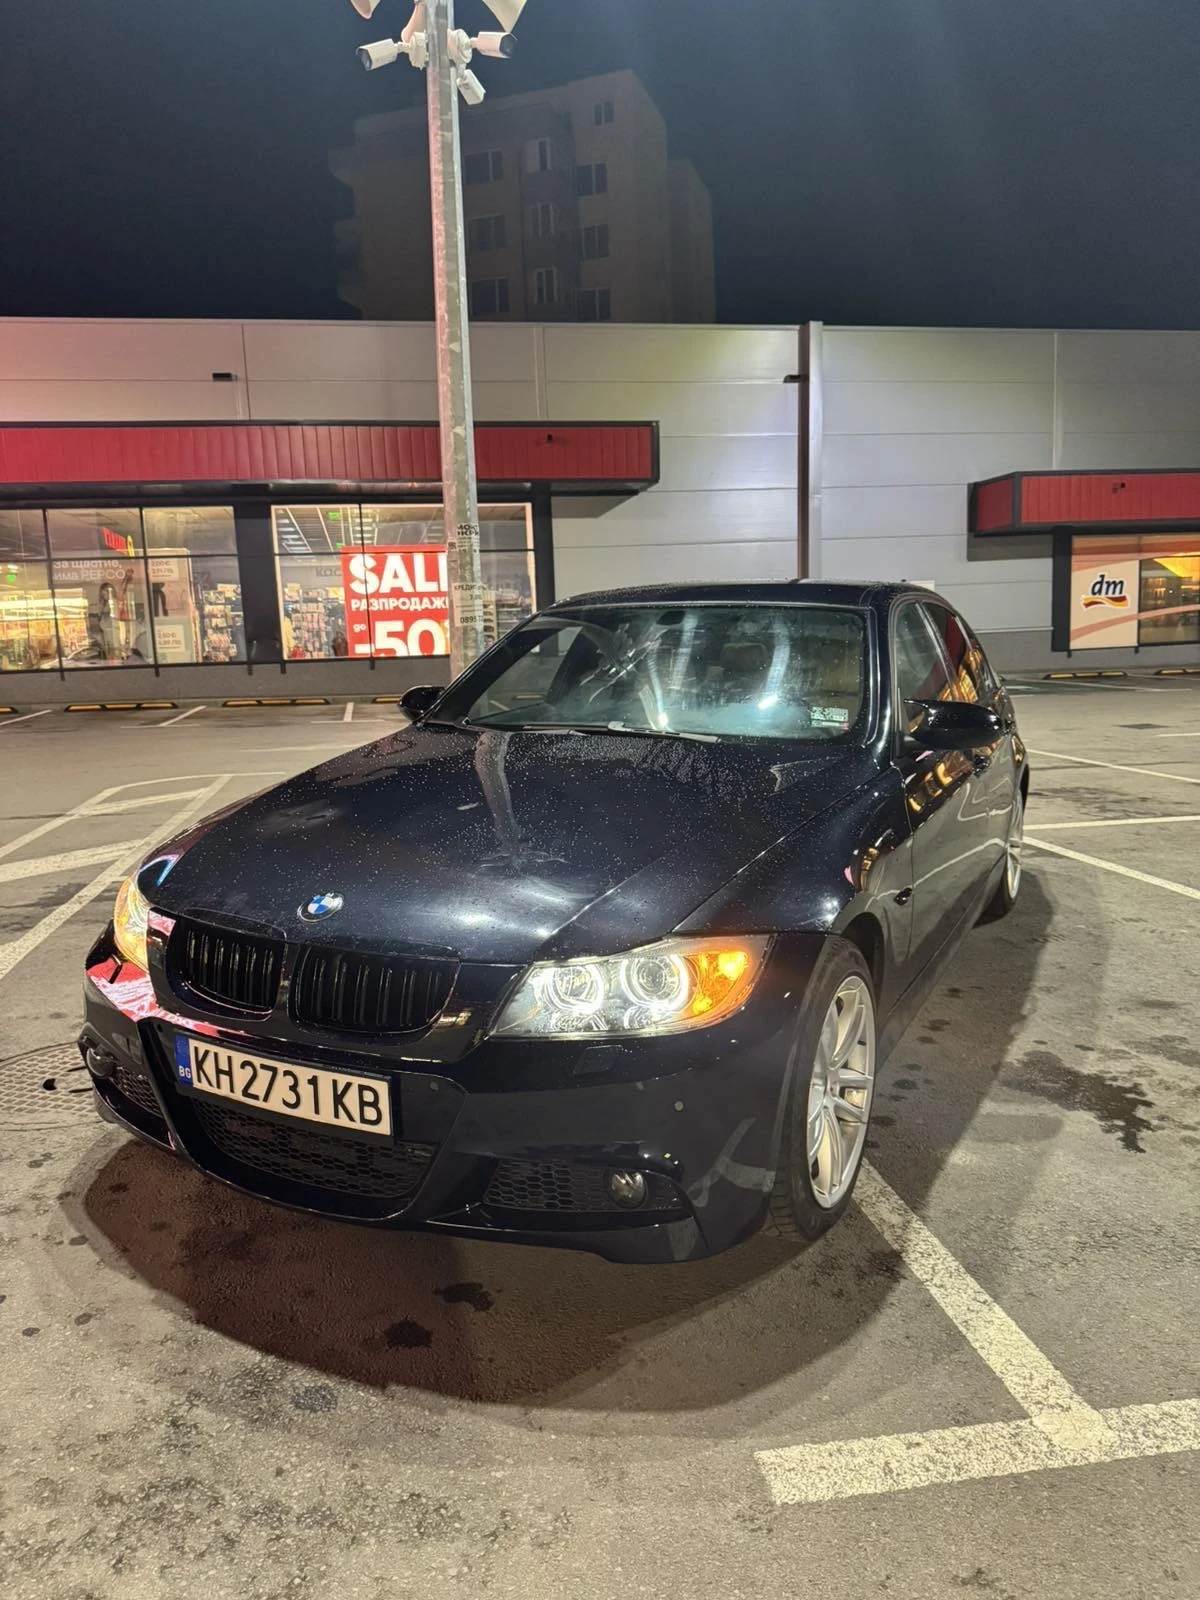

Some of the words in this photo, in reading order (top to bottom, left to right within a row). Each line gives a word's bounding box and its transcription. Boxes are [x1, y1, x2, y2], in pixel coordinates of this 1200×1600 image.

[80, 569, 126, 581] PEPCO
[316, 567, 342, 576] кас
[1091, 574, 1124, 596] dm
[351, 597, 448, 611] РАЗПРОДАЖ
[354, 618, 449, 656] -50
[179, 1065, 191, 1079] BG
[194, 1046, 382, 1126] KH2731KB
